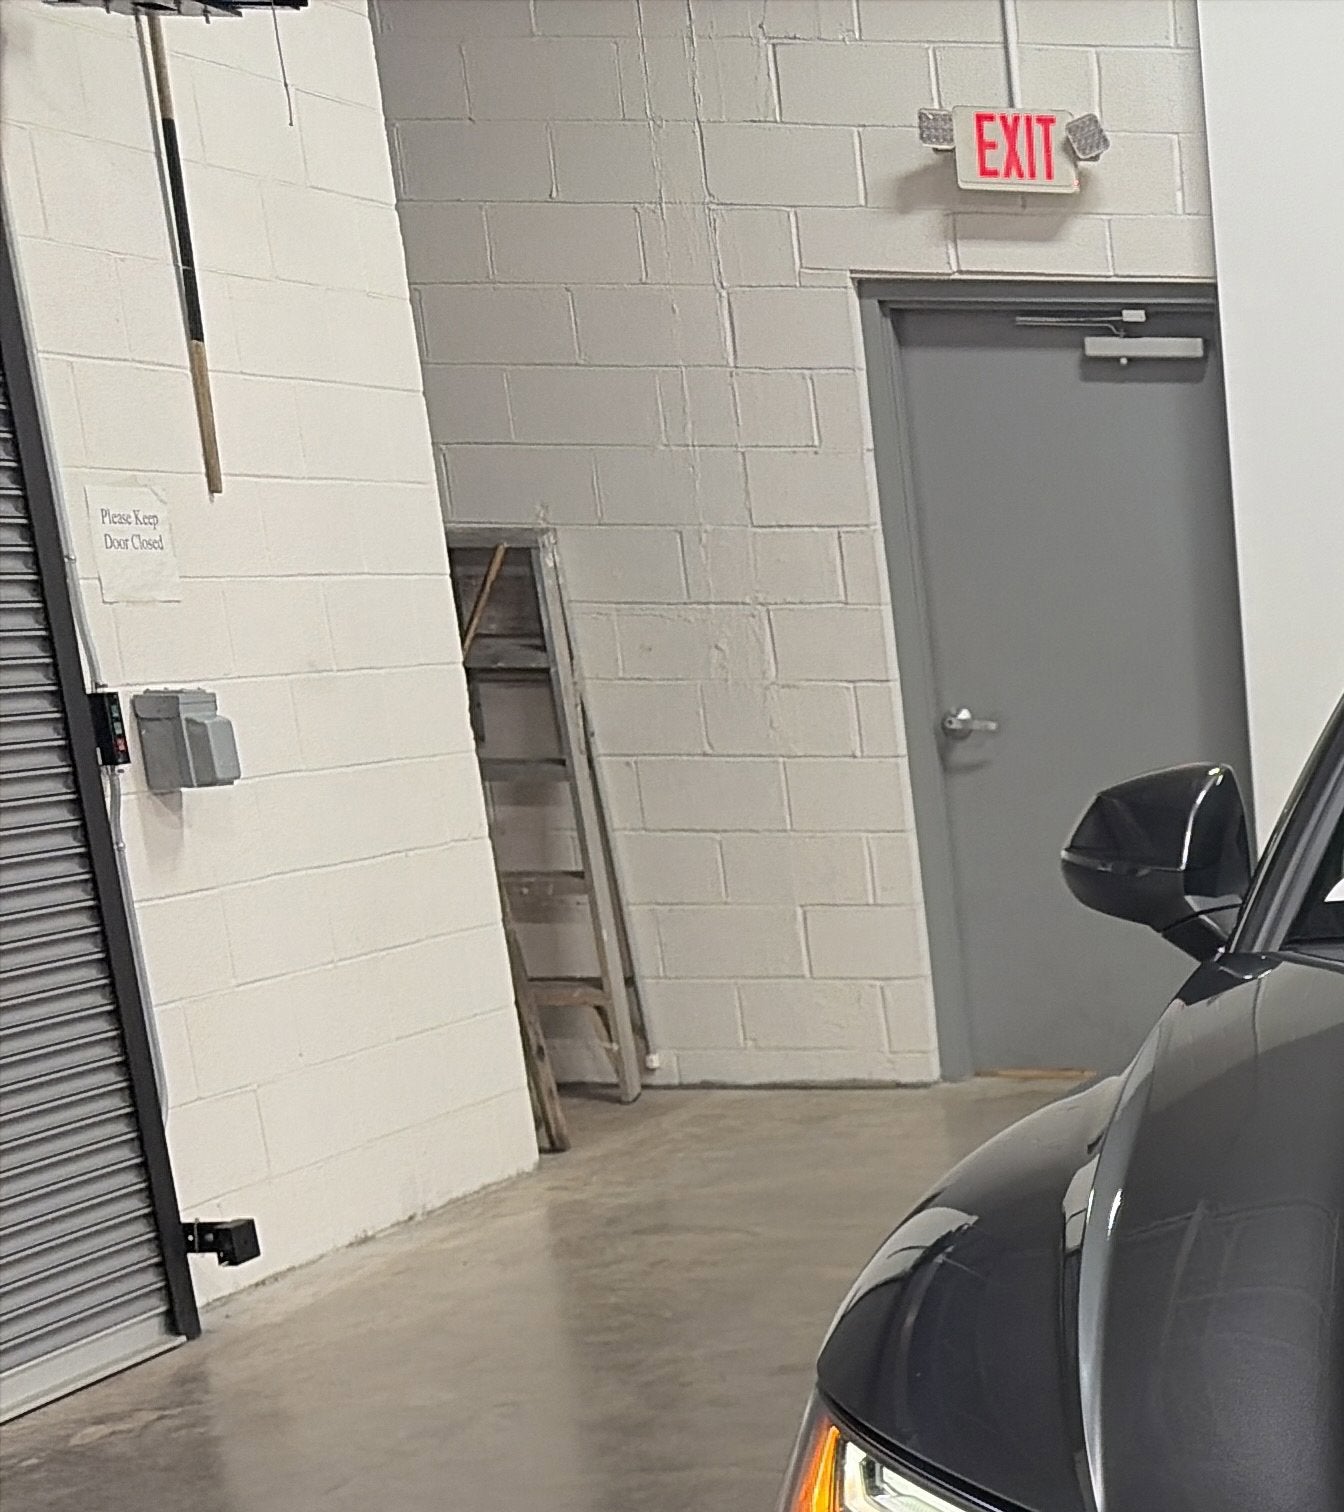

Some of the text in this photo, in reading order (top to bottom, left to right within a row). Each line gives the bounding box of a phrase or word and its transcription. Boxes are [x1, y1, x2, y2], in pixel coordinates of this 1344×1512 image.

[973, 111, 1056, 181] EXIT
[100, 508, 158, 530] Please Keep
[104, 533, 164, 550] Door Closed
